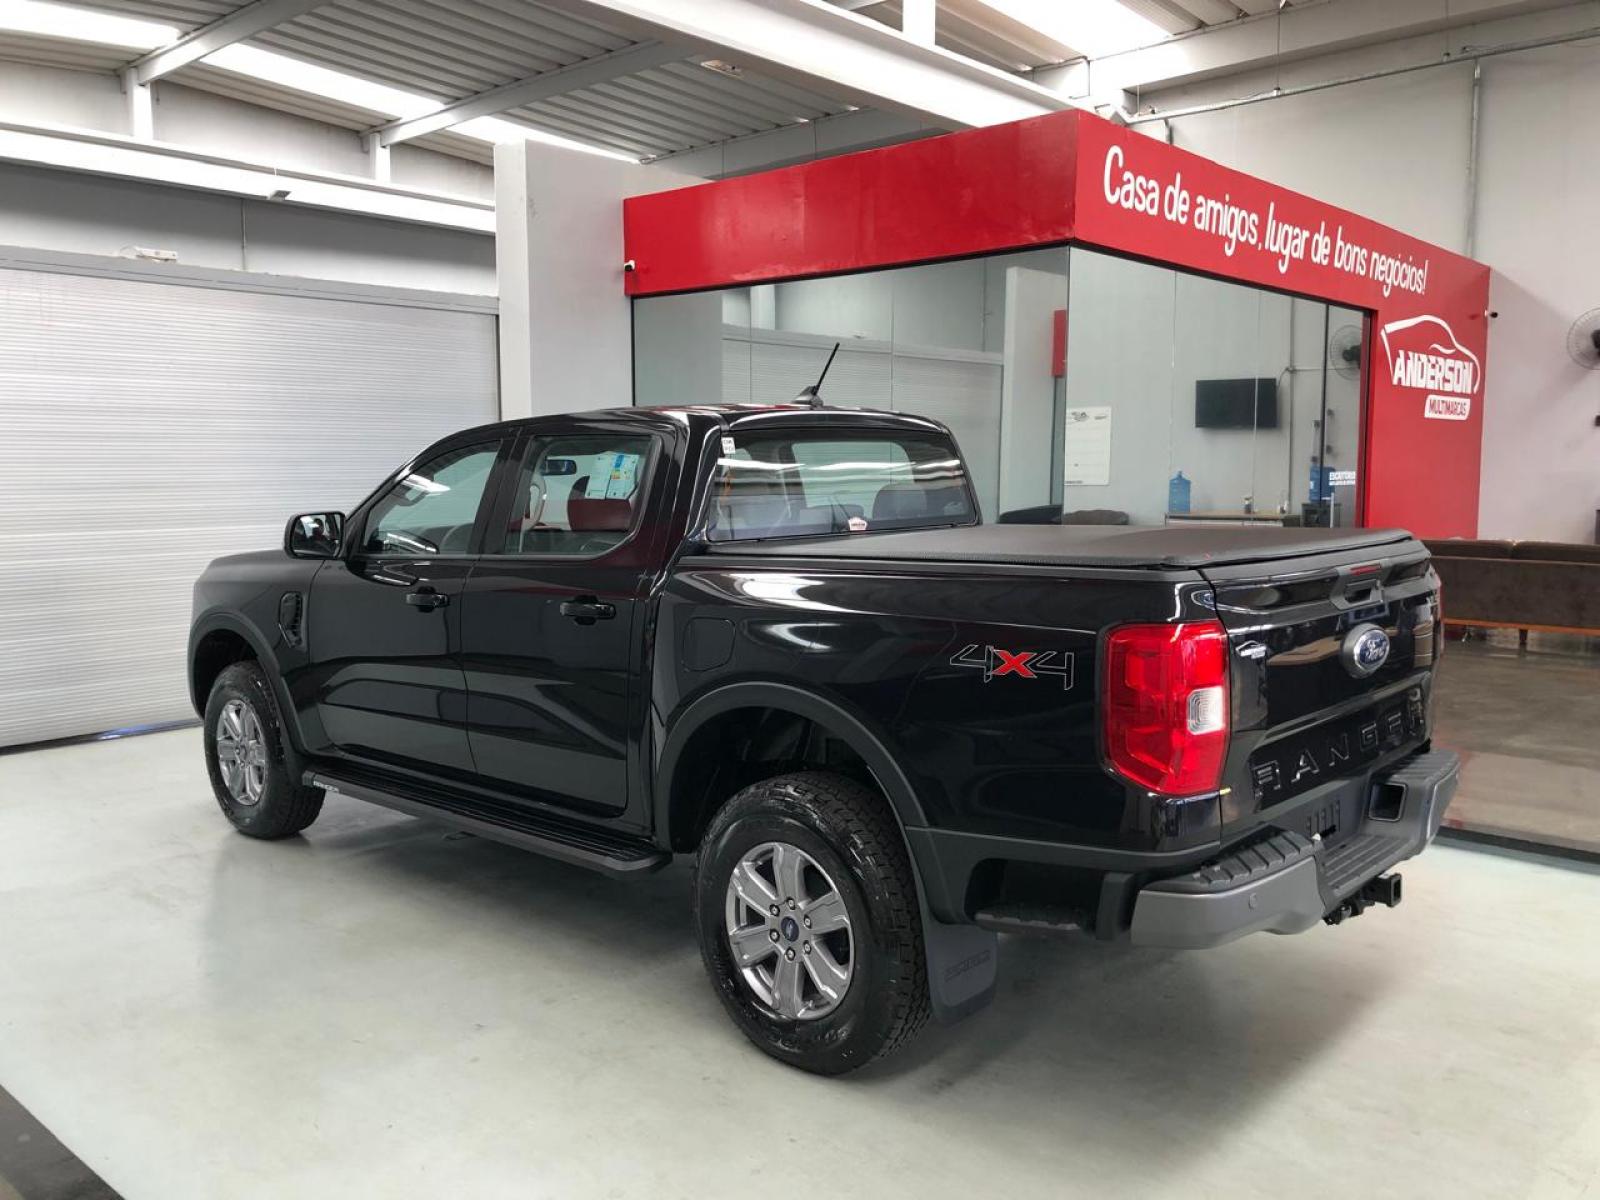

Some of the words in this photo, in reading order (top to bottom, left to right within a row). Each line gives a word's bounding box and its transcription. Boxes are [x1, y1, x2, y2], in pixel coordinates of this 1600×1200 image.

[1104, 145, 1160, 216] Casa
[1164, 172, 1190, 225] de
[1194, 193, 1263, 257] amigos,
[1265, 201, 1310, 274] lugar
[1311, 220, 1331, 266] de
[1334, 225, 1368, 277] bons
[1369, 250, 1428, 299] negócios!
[1392, 349, 1474, 394] ANDERSON
[1427, 398, 1468, 416] MULTIMARCAS
[1251, 686, 1427, 802] RANGER
